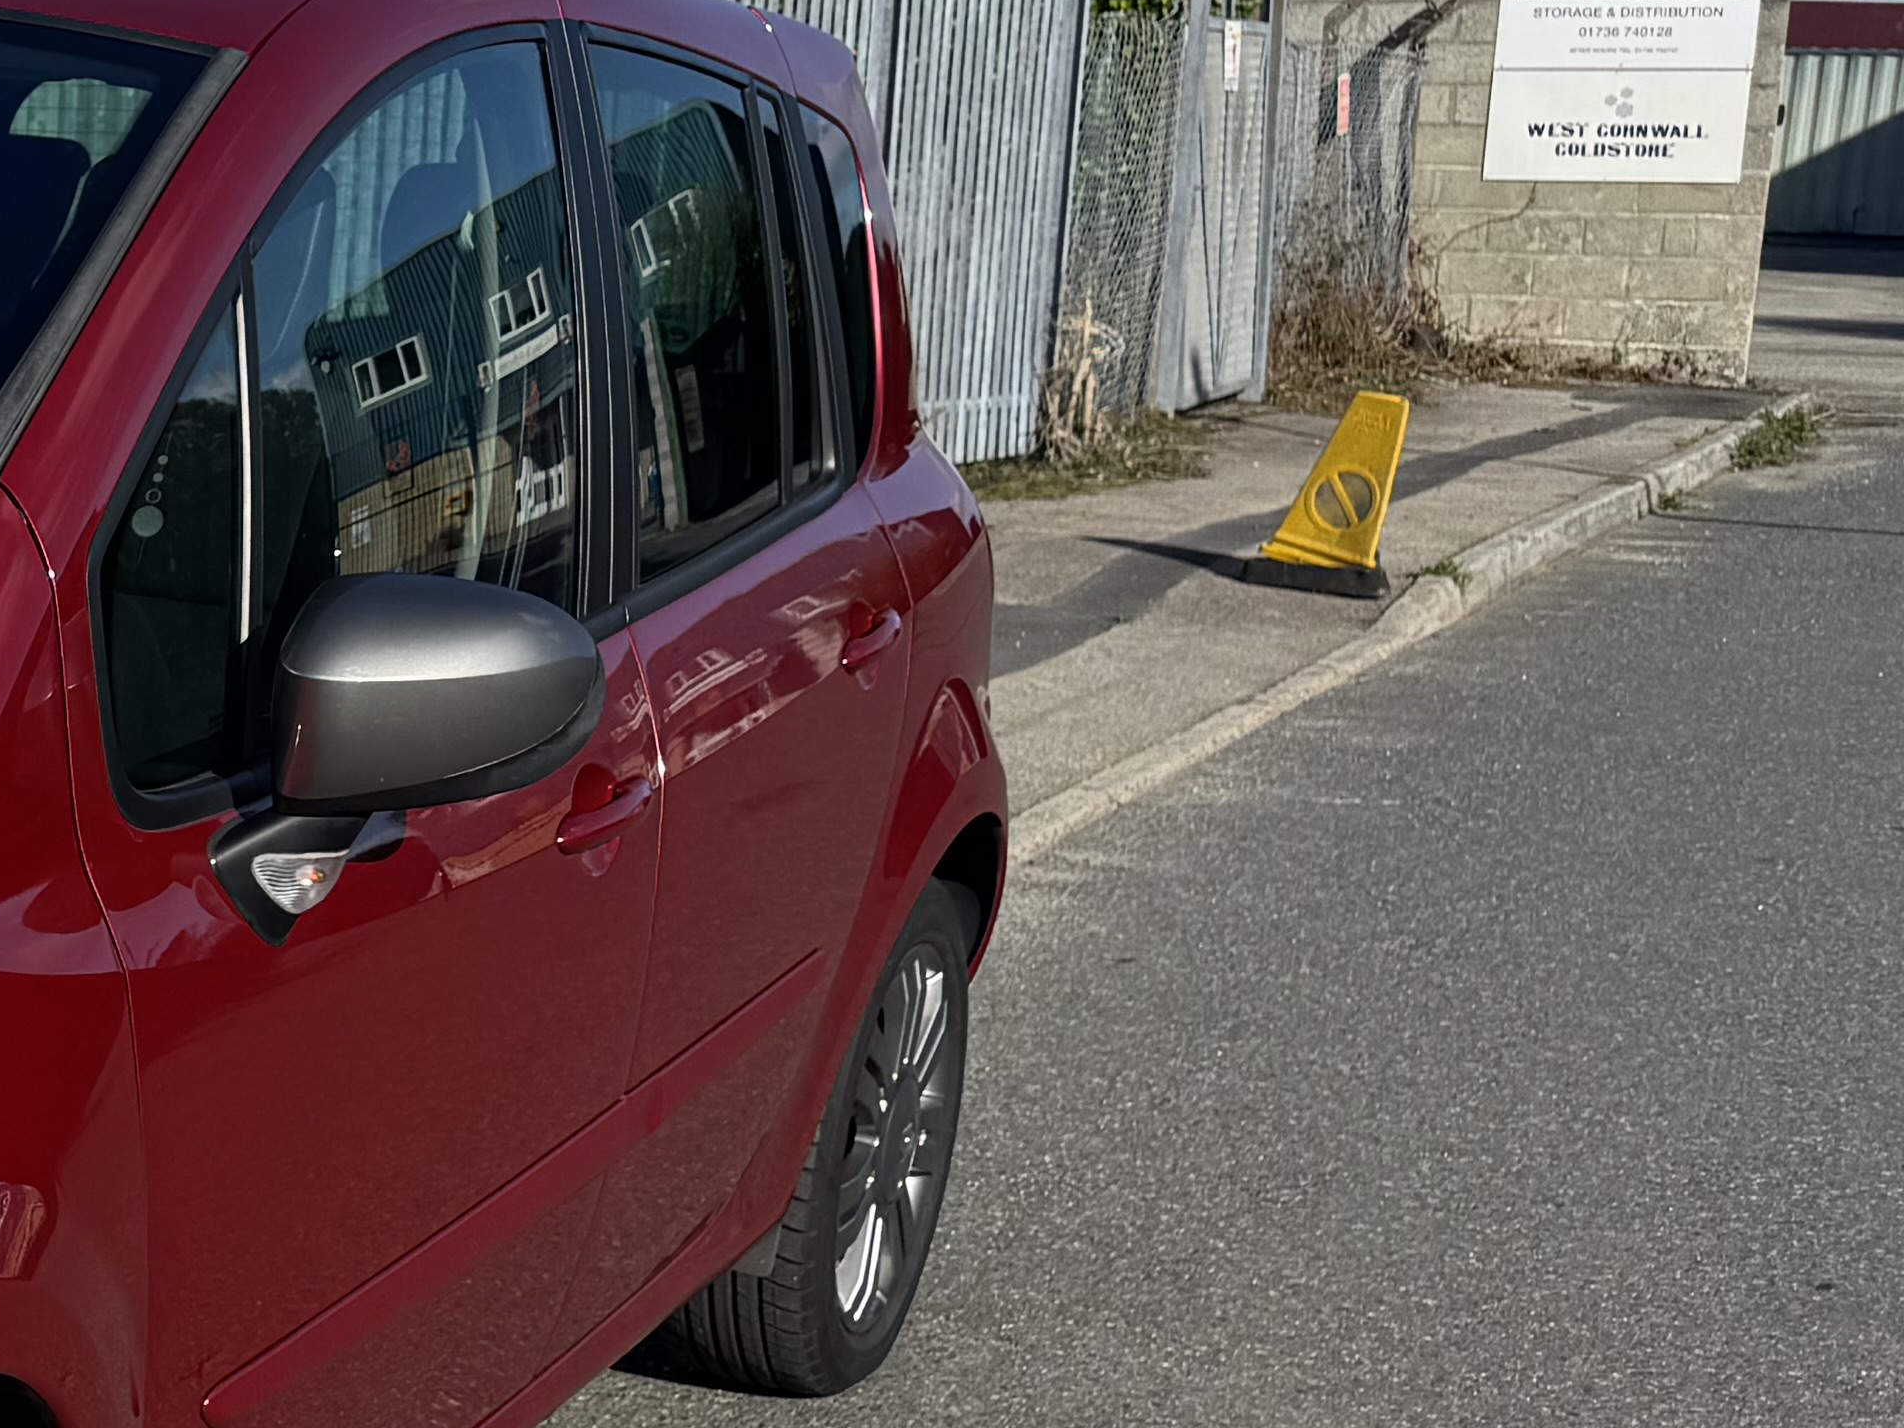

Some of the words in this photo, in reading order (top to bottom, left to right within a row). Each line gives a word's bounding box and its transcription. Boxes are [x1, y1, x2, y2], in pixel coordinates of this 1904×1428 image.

[1533, 6, 1602, 19] STORAGE
[1620, 6, 1724, 18] DISTRIBUTION
[1528, 123, 1589, 138] WEST
